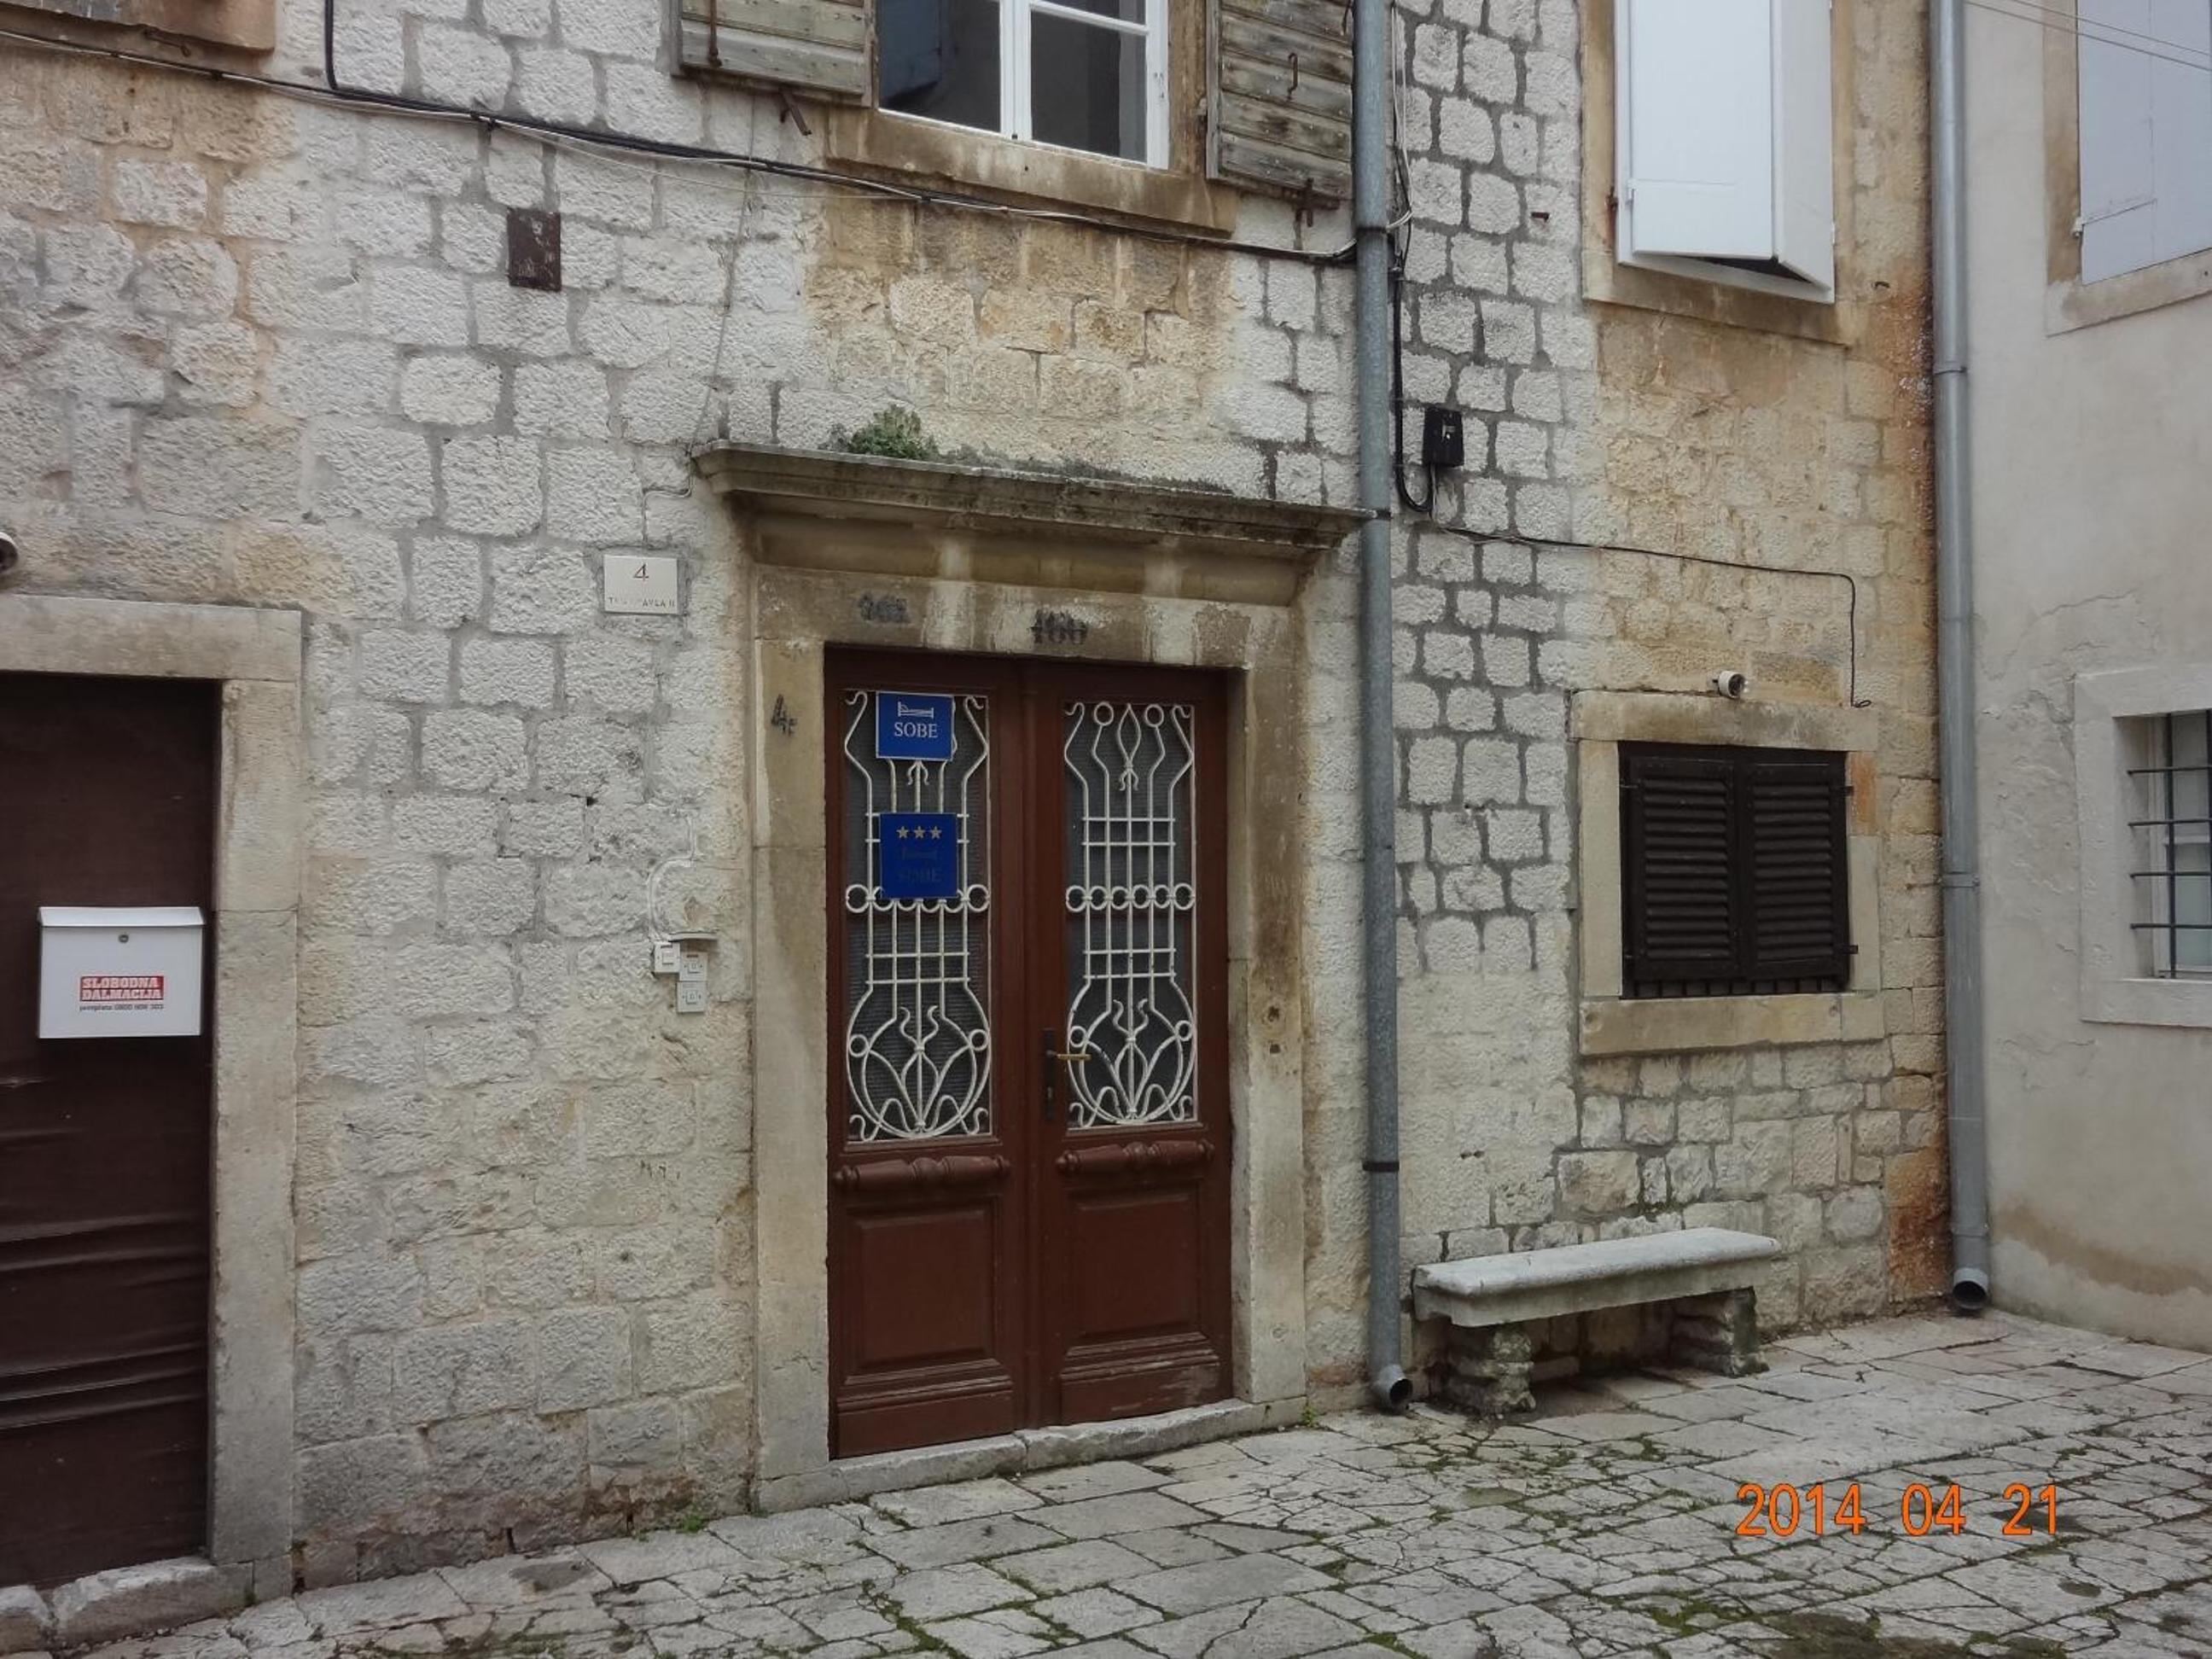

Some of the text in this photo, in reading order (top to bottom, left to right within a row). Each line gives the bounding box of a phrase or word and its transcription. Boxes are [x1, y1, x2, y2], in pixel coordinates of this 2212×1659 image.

[633, 563, 649, 582] 4
[894, 722, 939, 739] SOBE
[82, 977, 160, 988] SLOBODNA
[82, 988, 162, 999] DALMACIJA
